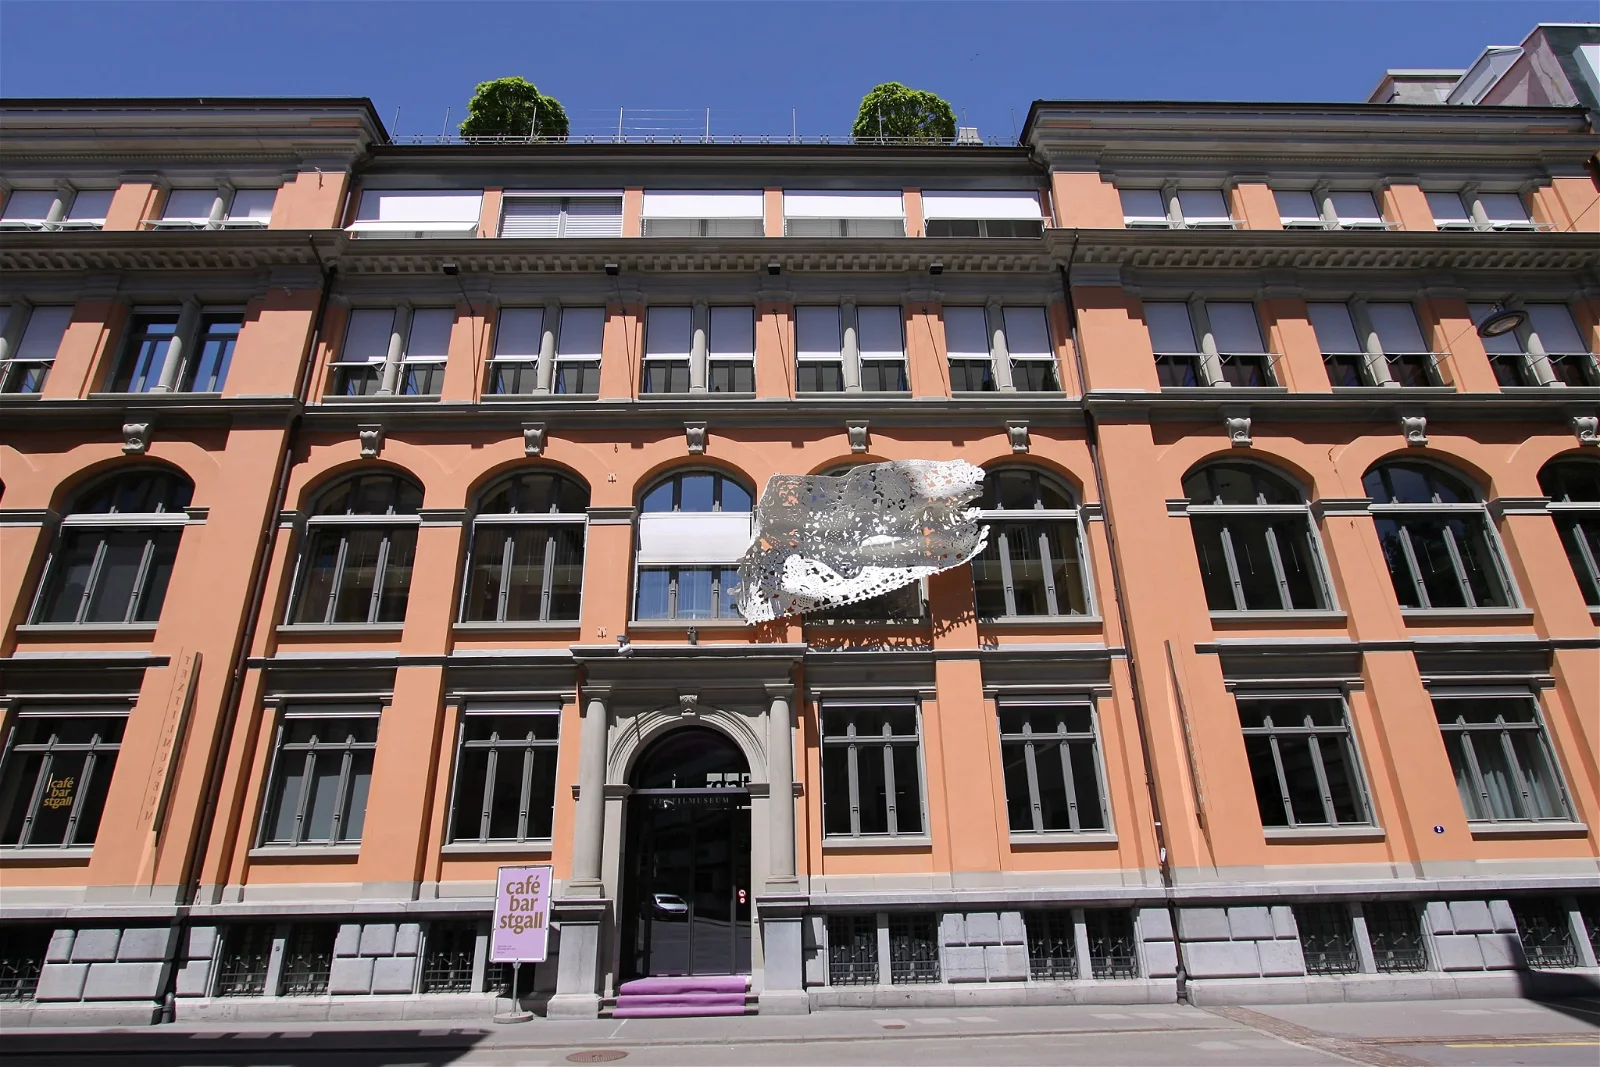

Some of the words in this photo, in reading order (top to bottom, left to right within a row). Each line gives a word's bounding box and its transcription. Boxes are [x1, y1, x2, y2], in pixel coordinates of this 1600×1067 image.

[50, 777, 73, 788] café
[52, 788, 71, 797] bar
[43, 796, 73, 809] stgall
[506, 875, 541, 895] café
[509, 895, 538, 912] bar
[499, 912, 544, 935] stgall
